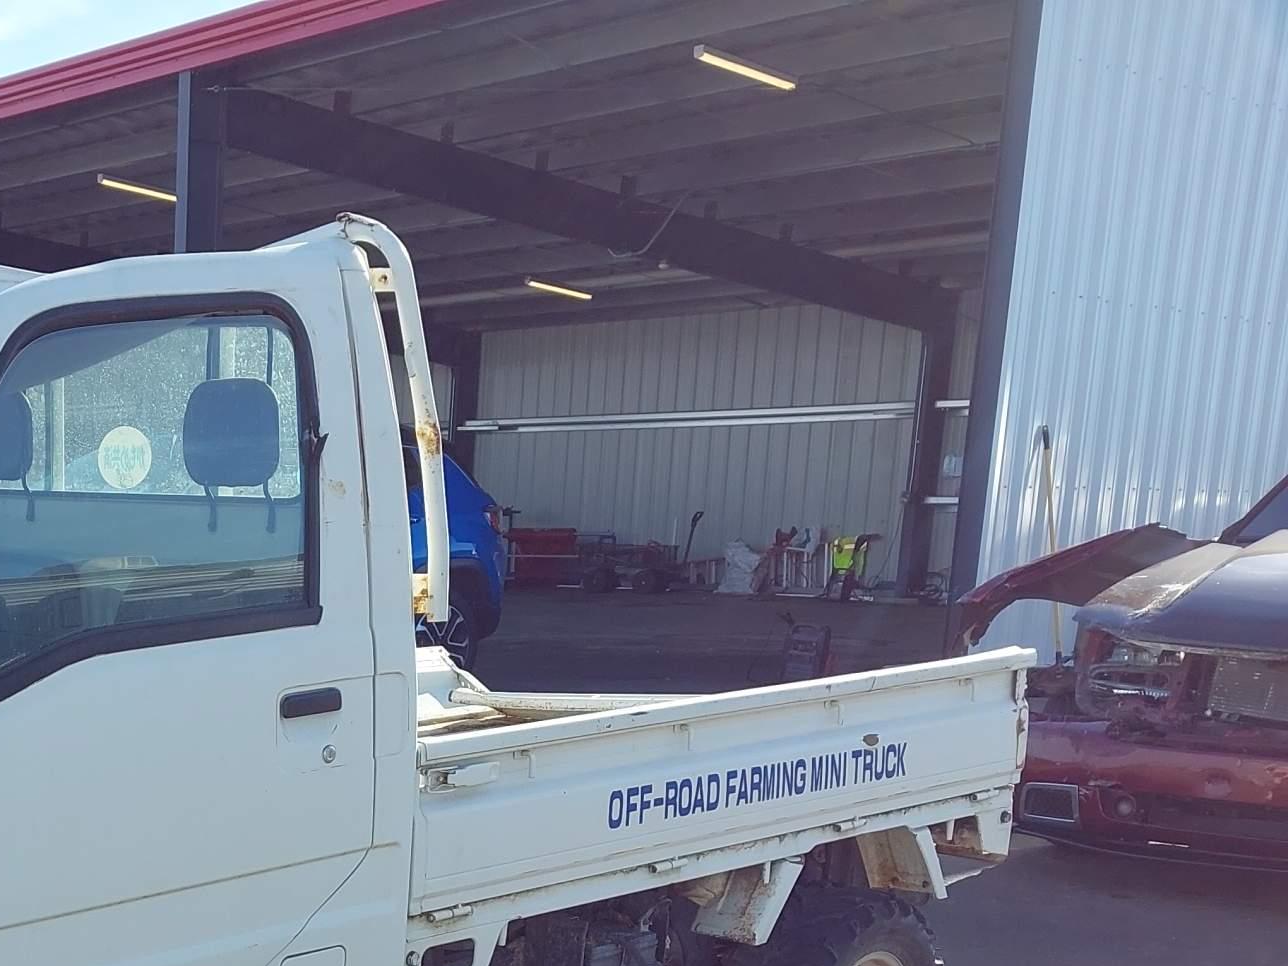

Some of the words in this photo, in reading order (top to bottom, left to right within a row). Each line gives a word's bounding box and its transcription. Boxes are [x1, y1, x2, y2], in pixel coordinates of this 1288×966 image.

[608, 773, 721, 829] OFF-ROAD
[725, 758, 807, 808] FARMING
[810, 751, 847, 793] MINI
[851, 742, 907, 785] TRUCK
